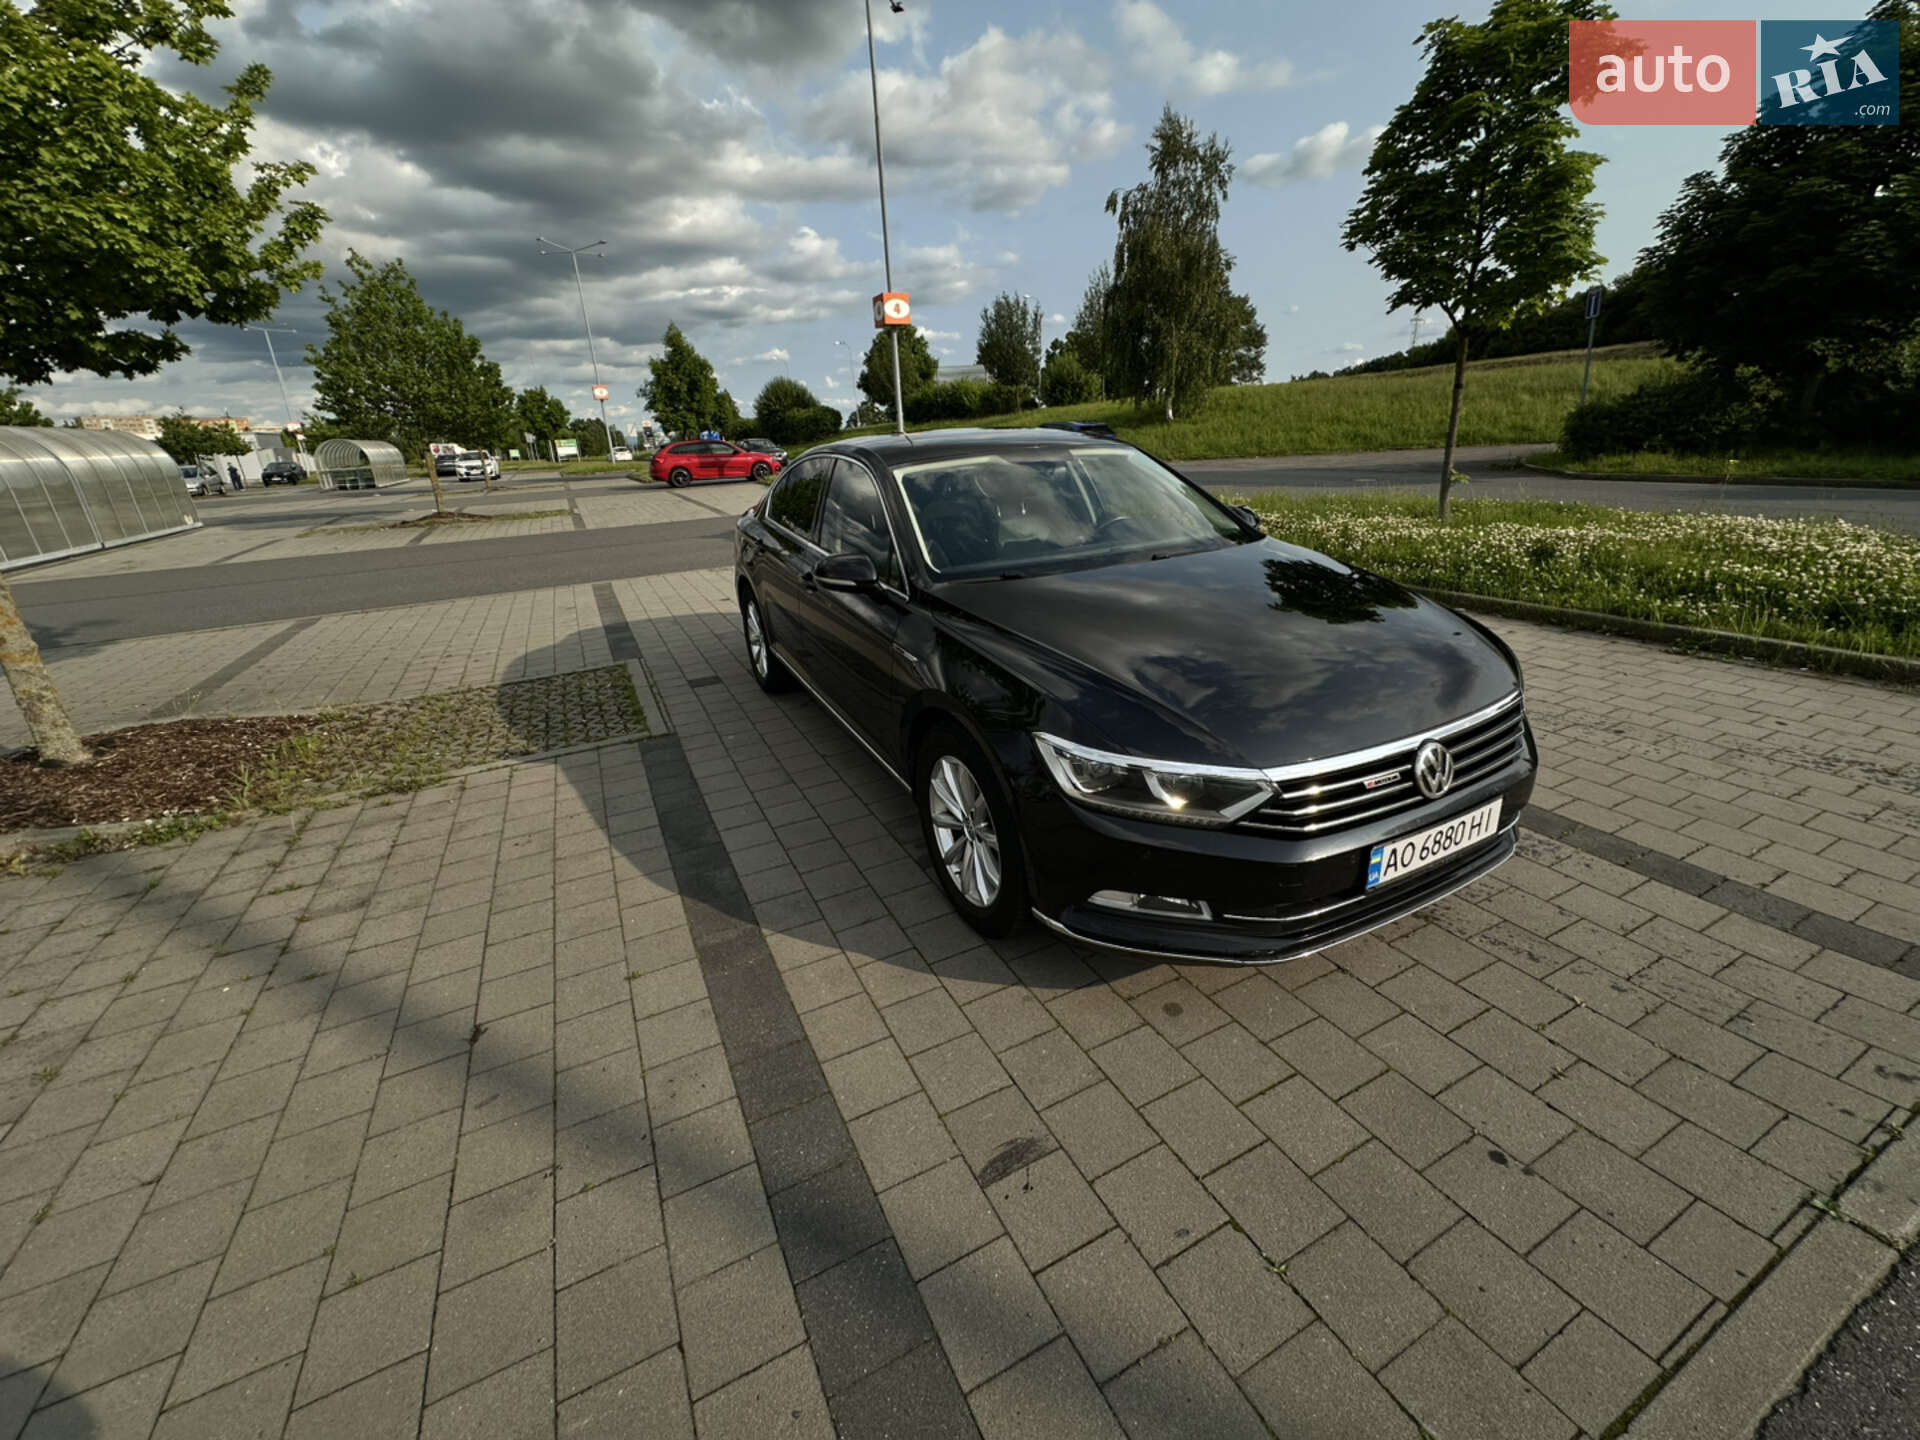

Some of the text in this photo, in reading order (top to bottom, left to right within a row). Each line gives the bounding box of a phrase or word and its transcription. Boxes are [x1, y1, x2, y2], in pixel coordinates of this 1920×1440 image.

[1383, 807, 1492, 877] AO 6880 HI
